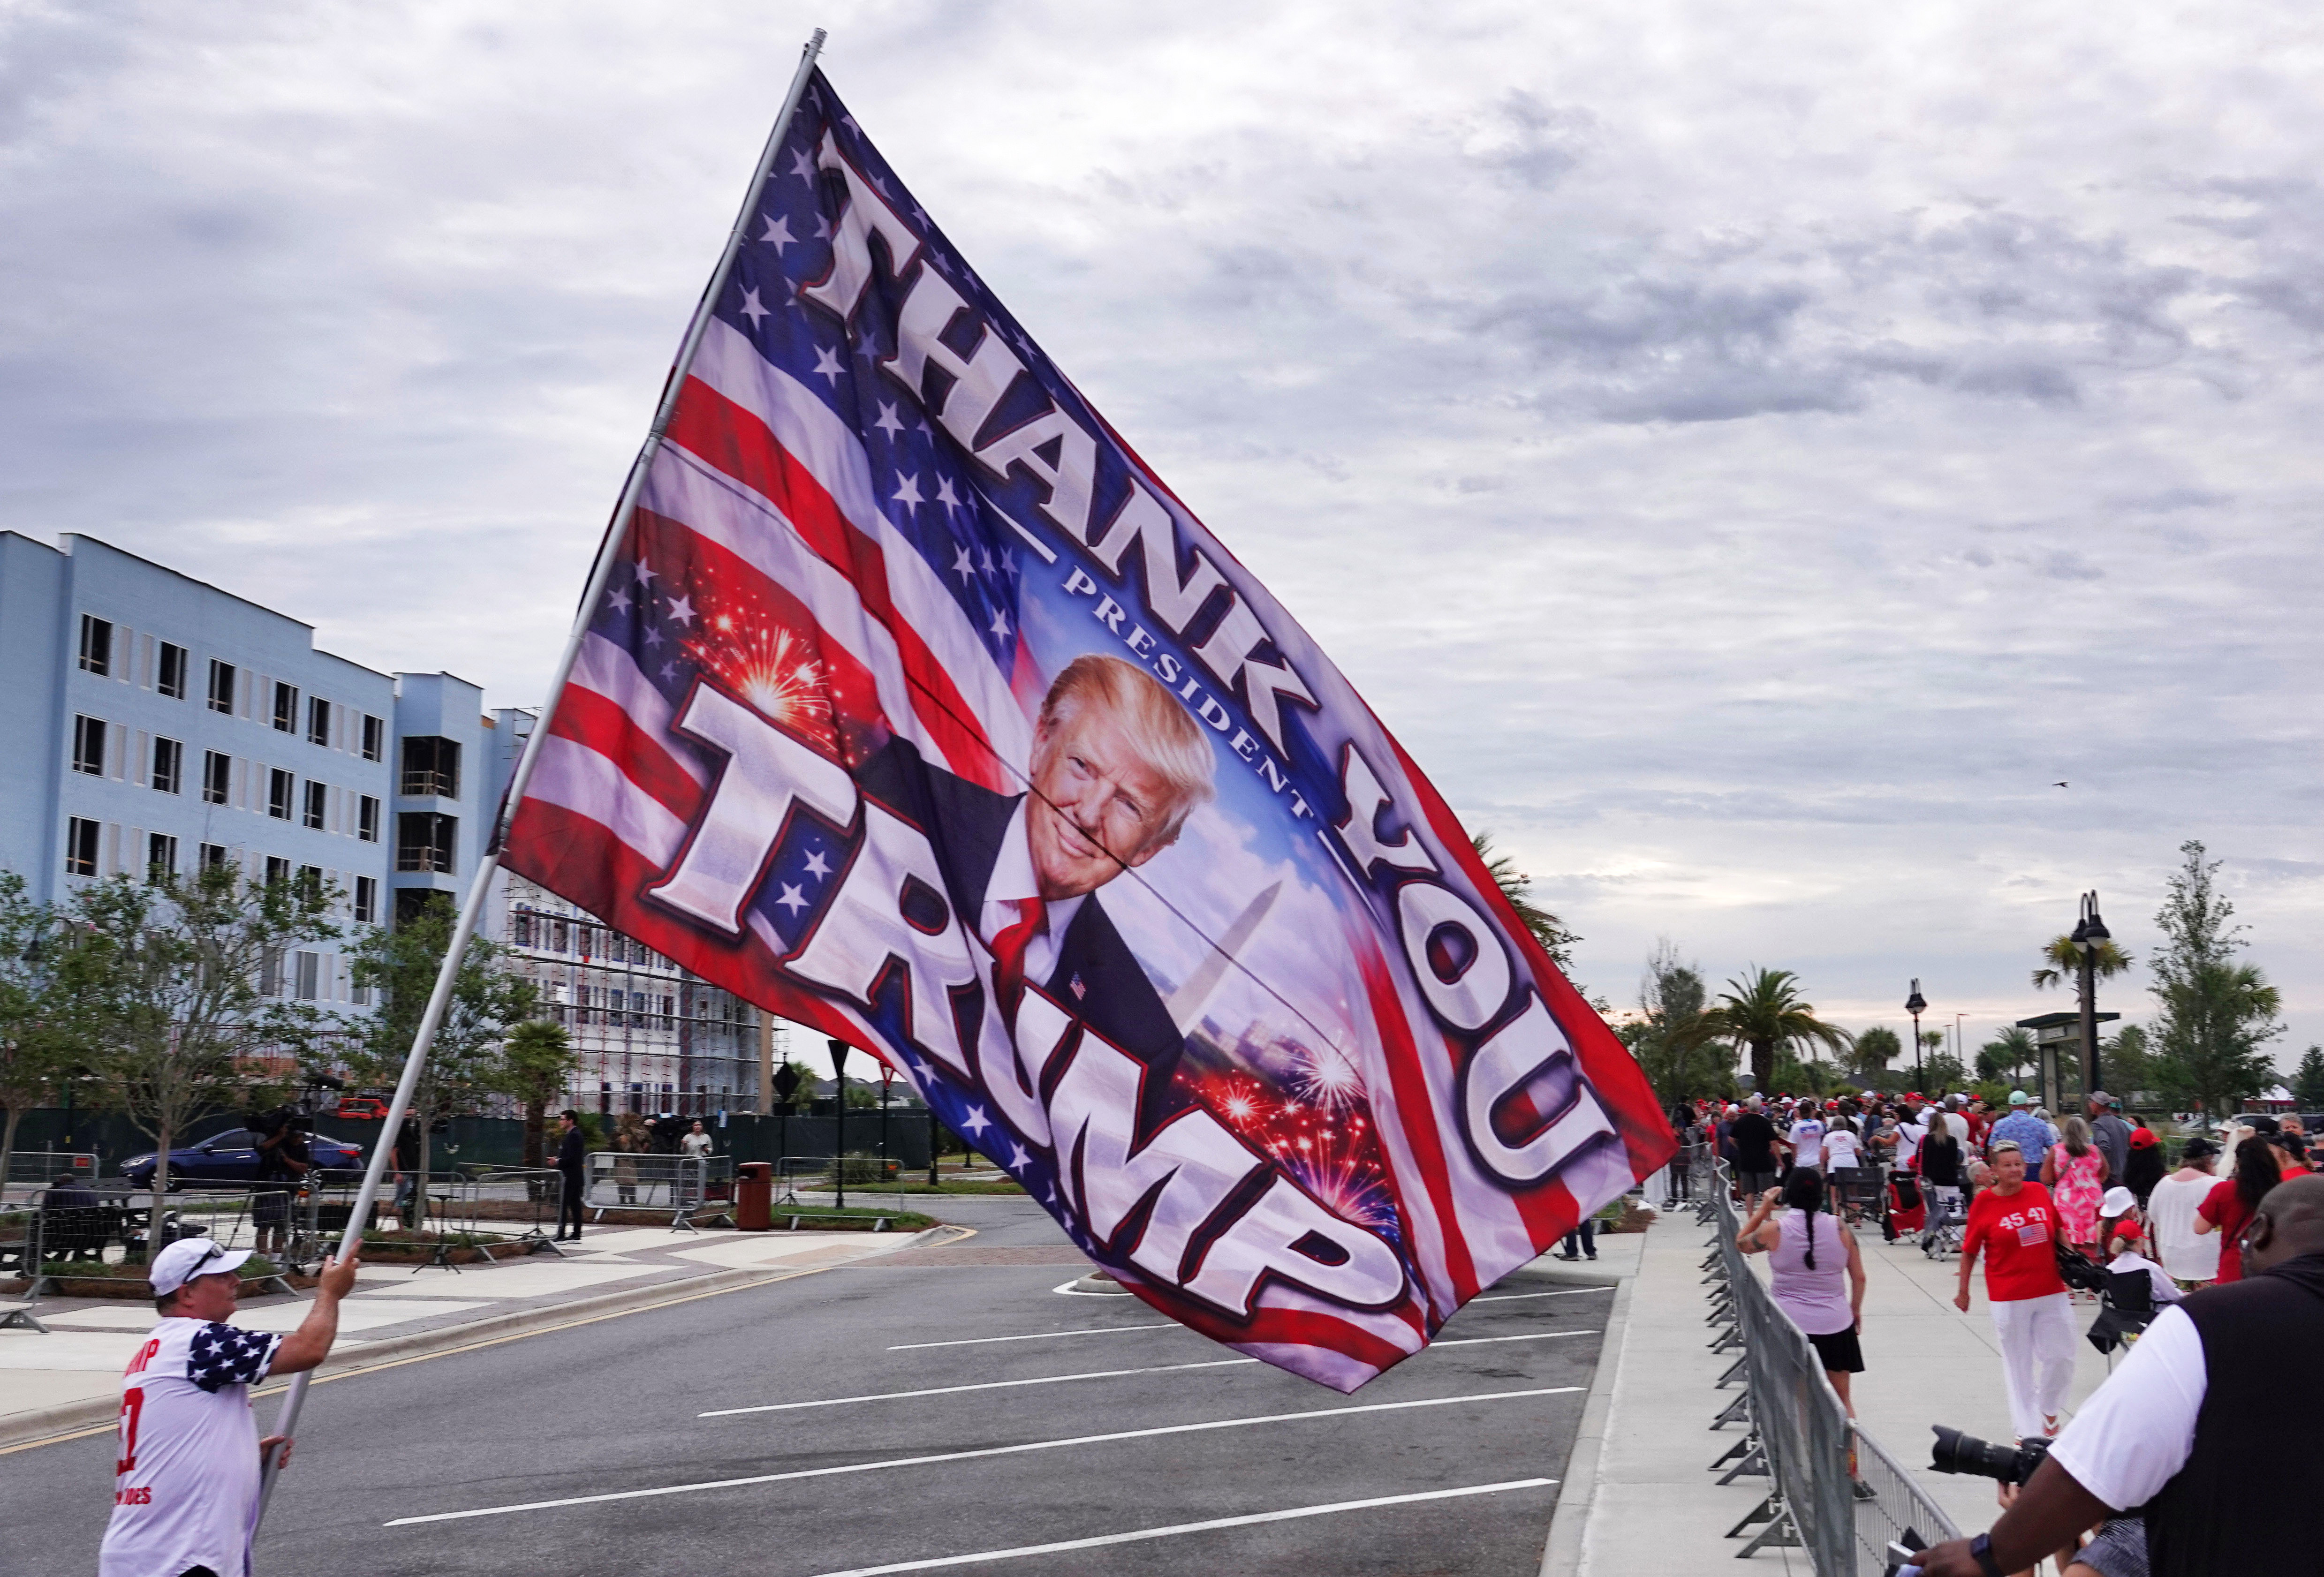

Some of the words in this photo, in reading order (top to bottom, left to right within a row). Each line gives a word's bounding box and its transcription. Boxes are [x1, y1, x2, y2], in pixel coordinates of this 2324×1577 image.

[798, 124, 1320, 761] THANK
[1334, 740, 1618, 1185] YOU
[1061, 565, 1314, 819] PRESIDENT
[645, 680, 1406, 1320] TRUMP
[1999, 1212, 2026, 1230] 45
[2027, 1207, 2048, 1221] 47
